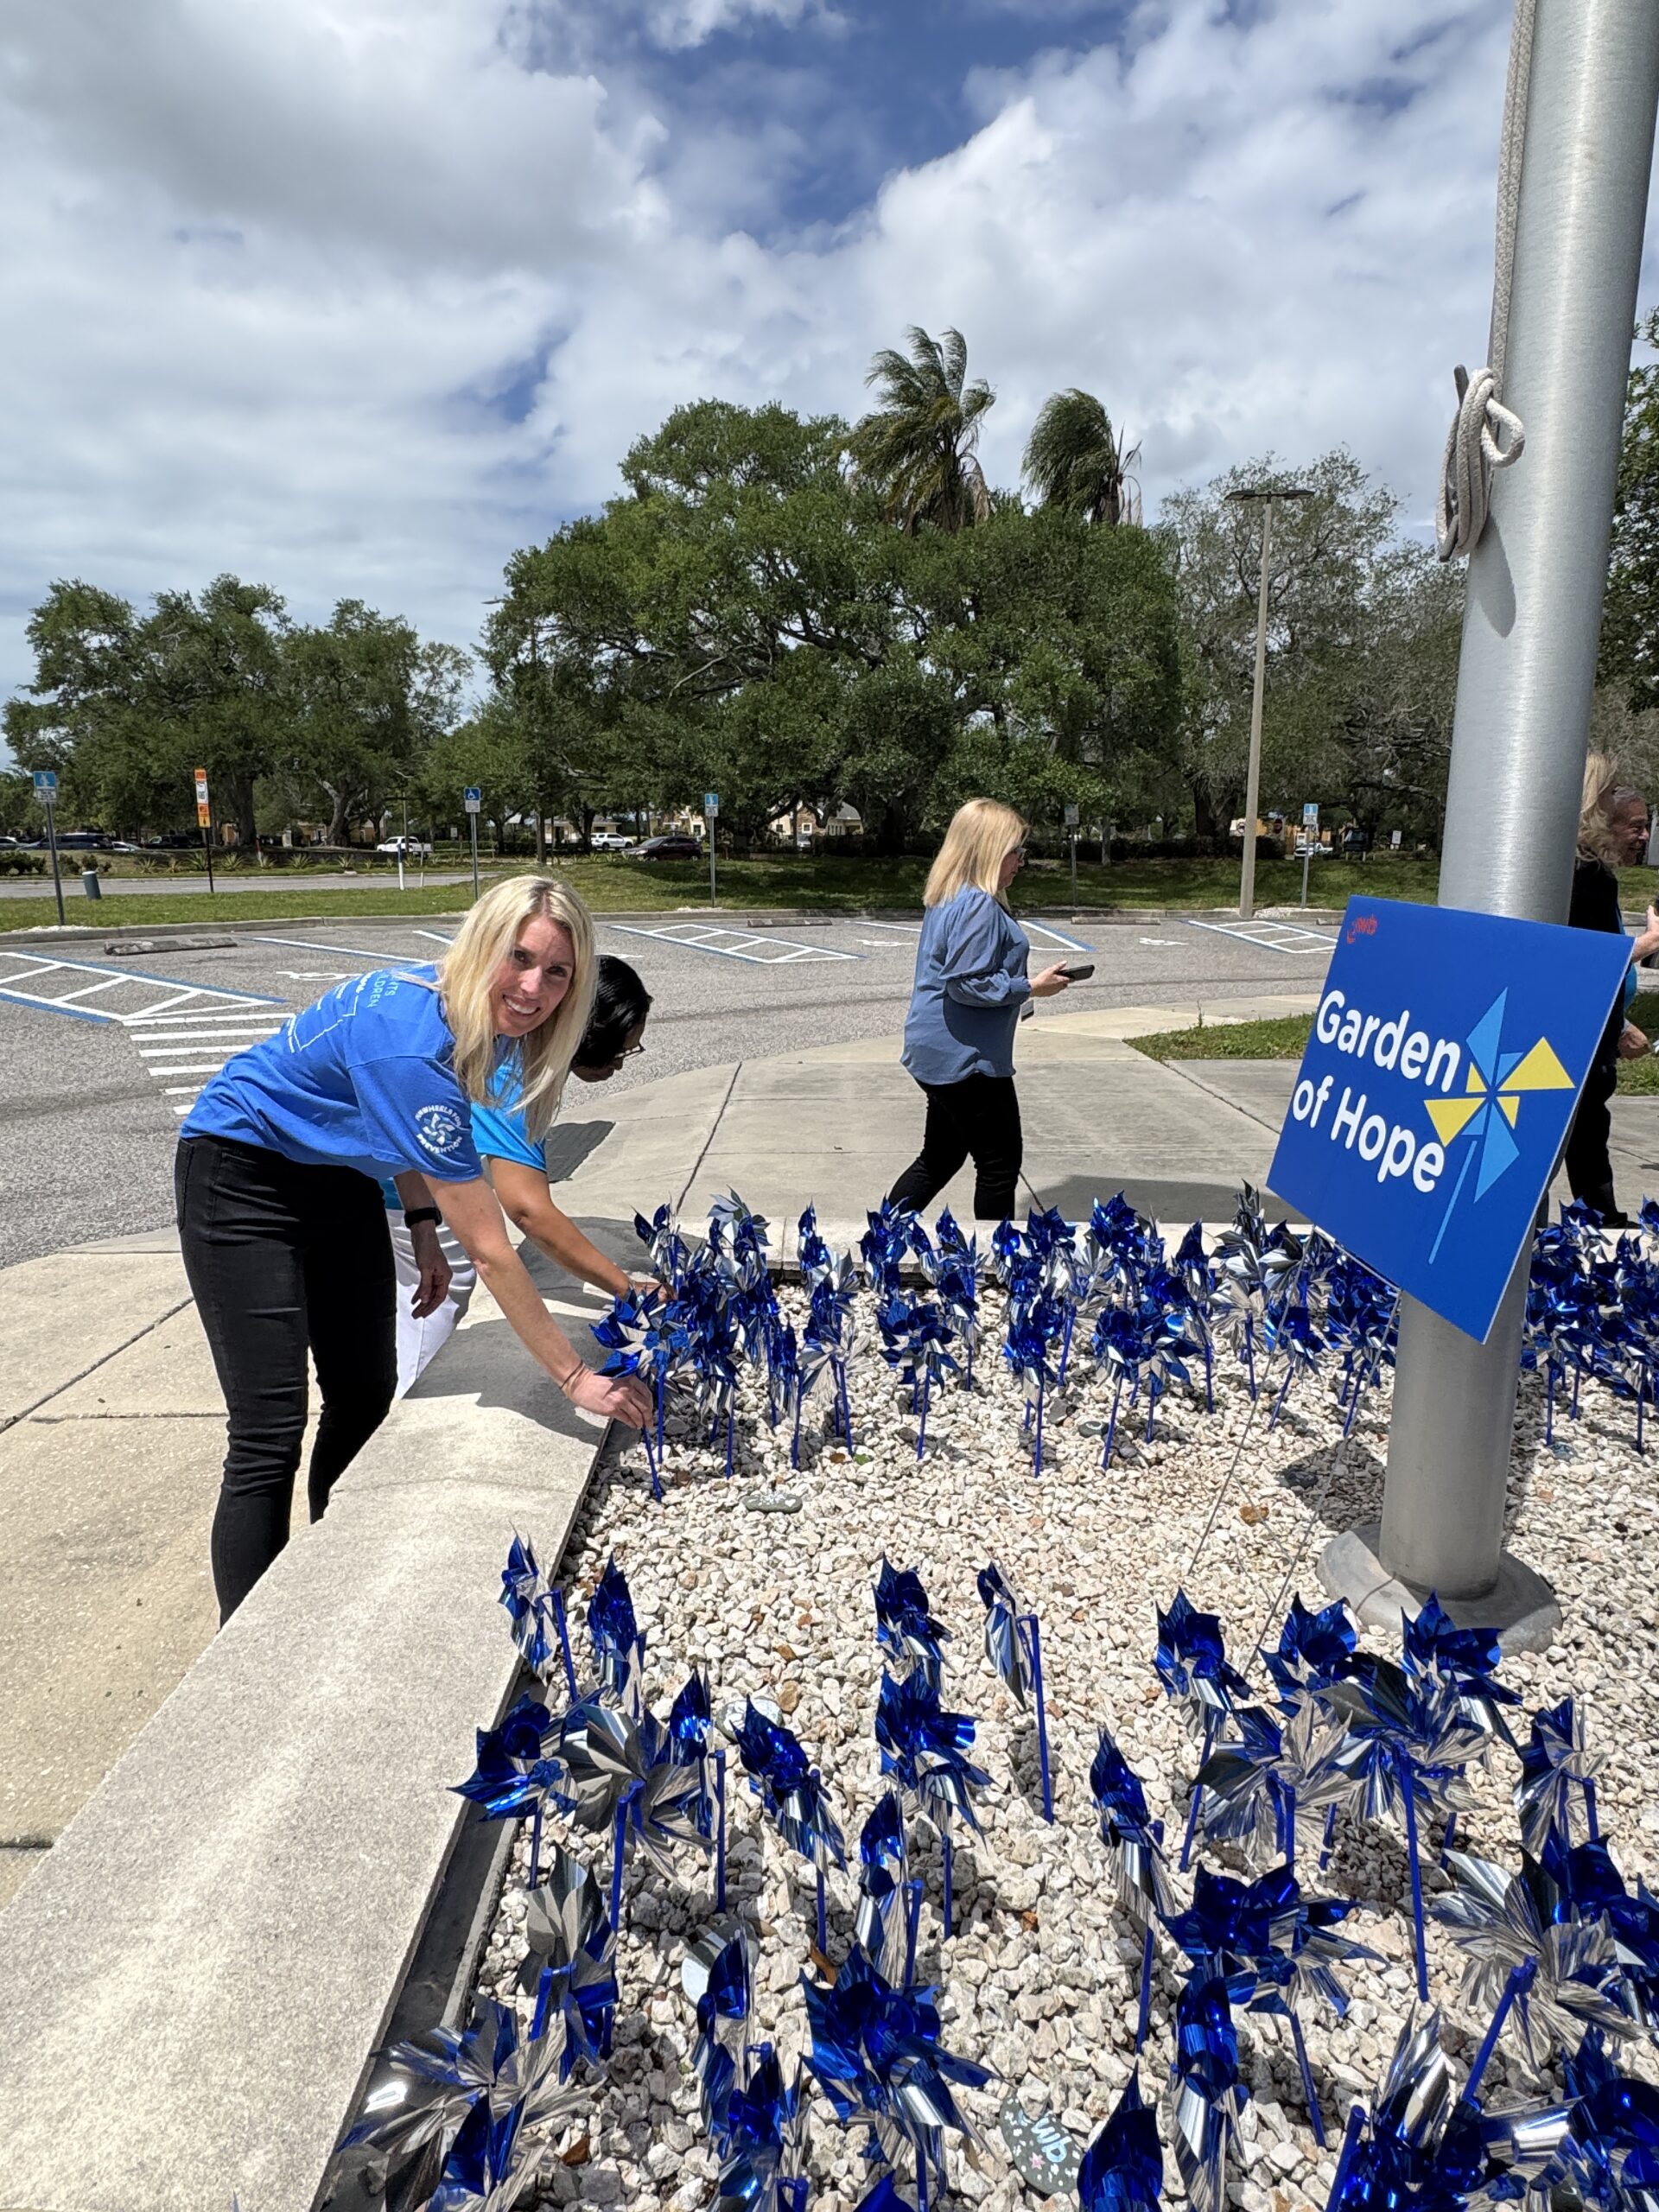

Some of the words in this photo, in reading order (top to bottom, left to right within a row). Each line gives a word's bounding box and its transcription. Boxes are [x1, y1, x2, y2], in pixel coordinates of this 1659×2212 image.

[1317, 989, 1461, 1092] Garden
[1293, 1075, 1334, 1128] of
[1331, 1086, 1446, 1193] Hope
